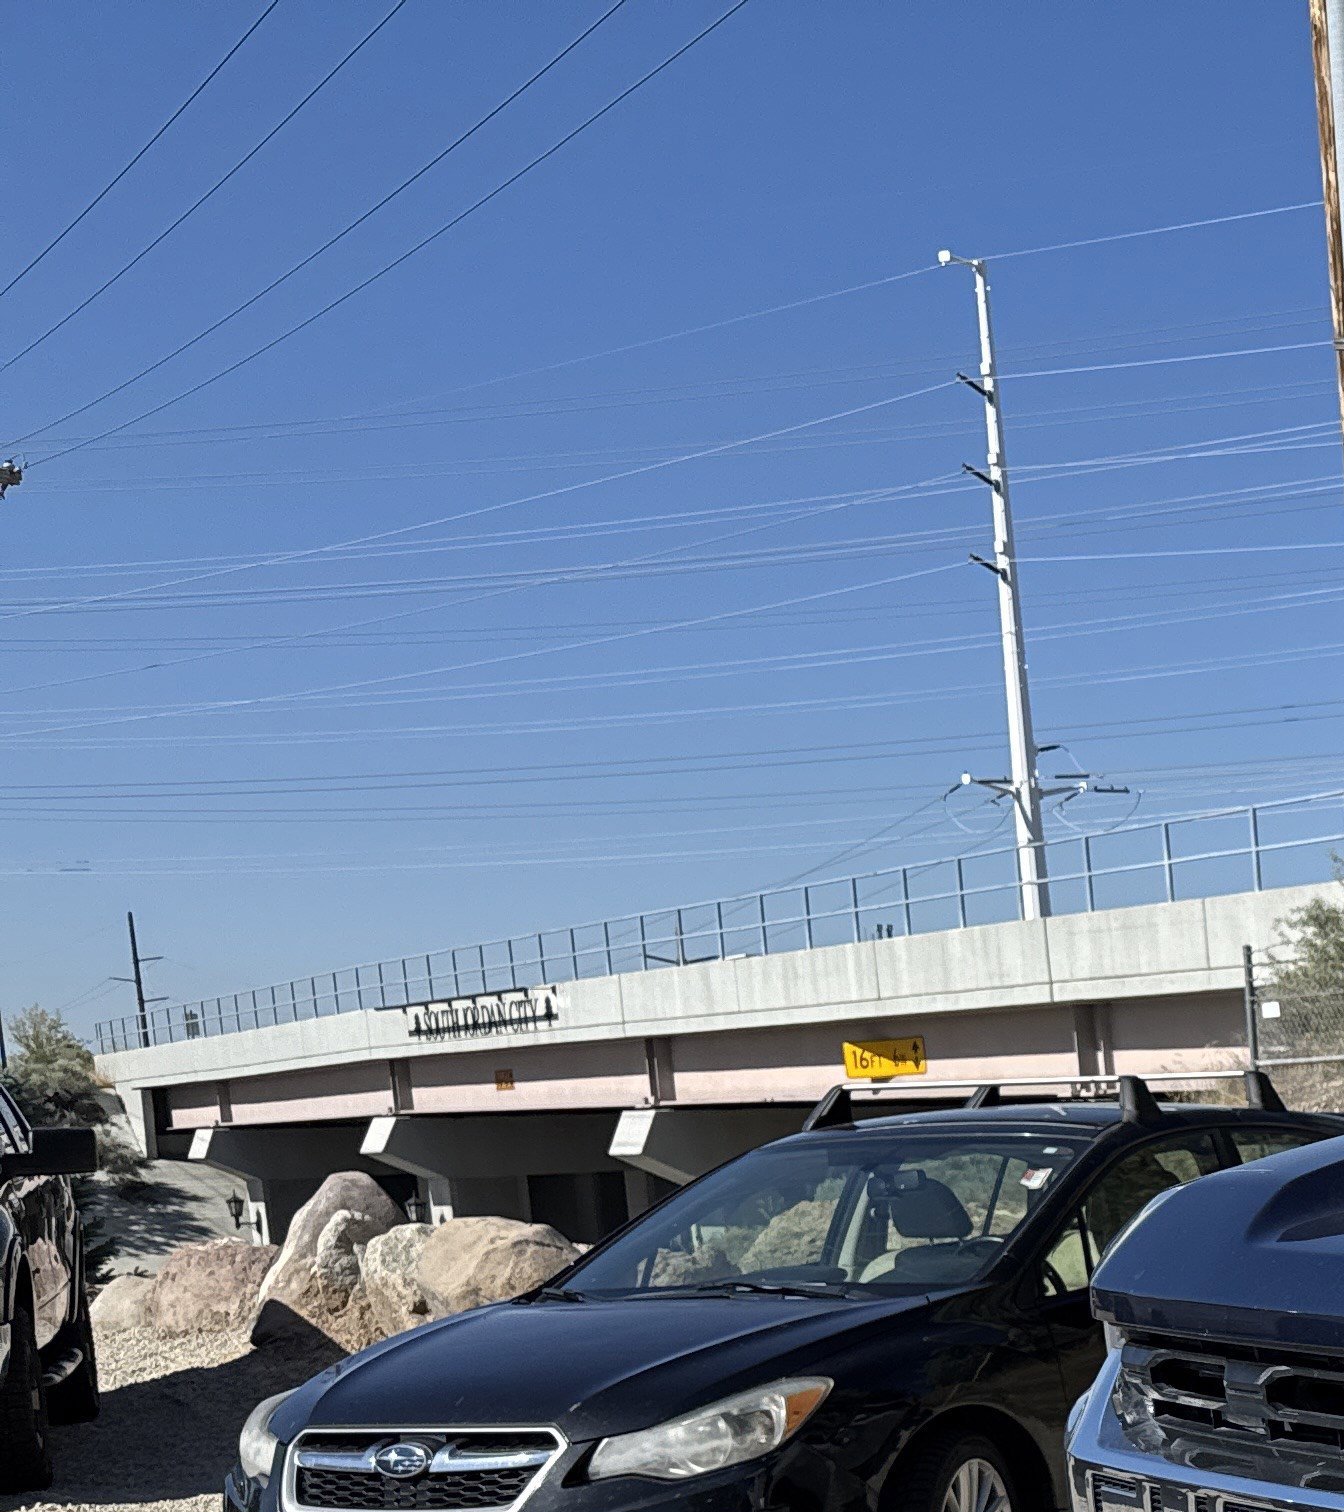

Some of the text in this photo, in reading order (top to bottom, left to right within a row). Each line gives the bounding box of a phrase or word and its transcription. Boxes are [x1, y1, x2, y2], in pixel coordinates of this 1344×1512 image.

[424, 998, 538, 1041] SOUTH JORDAN CITY
